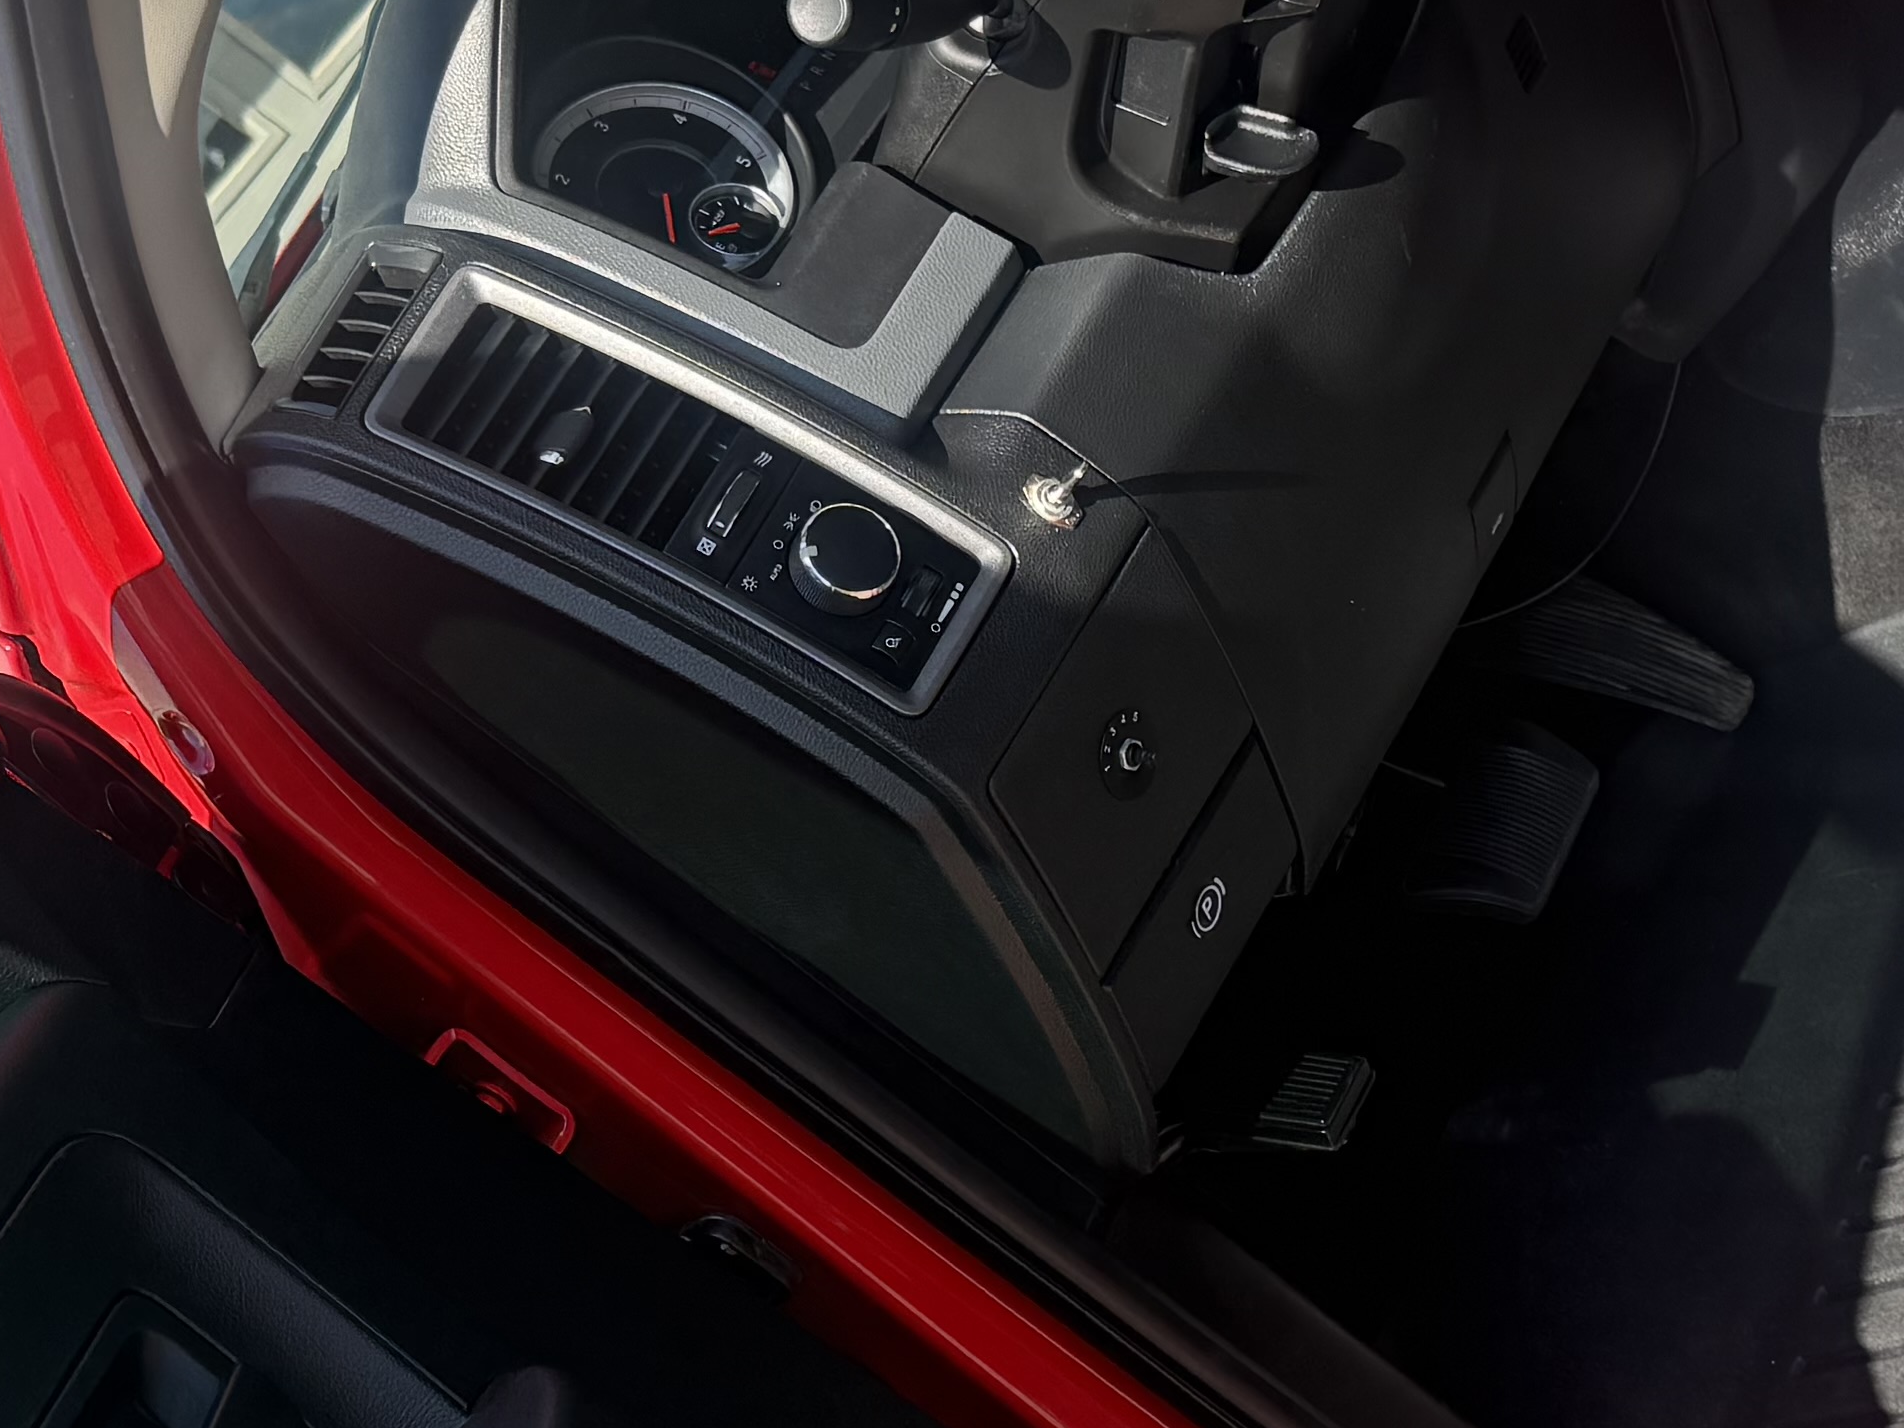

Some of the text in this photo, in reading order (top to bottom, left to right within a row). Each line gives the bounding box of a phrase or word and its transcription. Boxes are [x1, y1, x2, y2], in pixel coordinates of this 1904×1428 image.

[555, 113, 752, 186] 2 3 4 5
[1201, 896, 1213, 921] P
